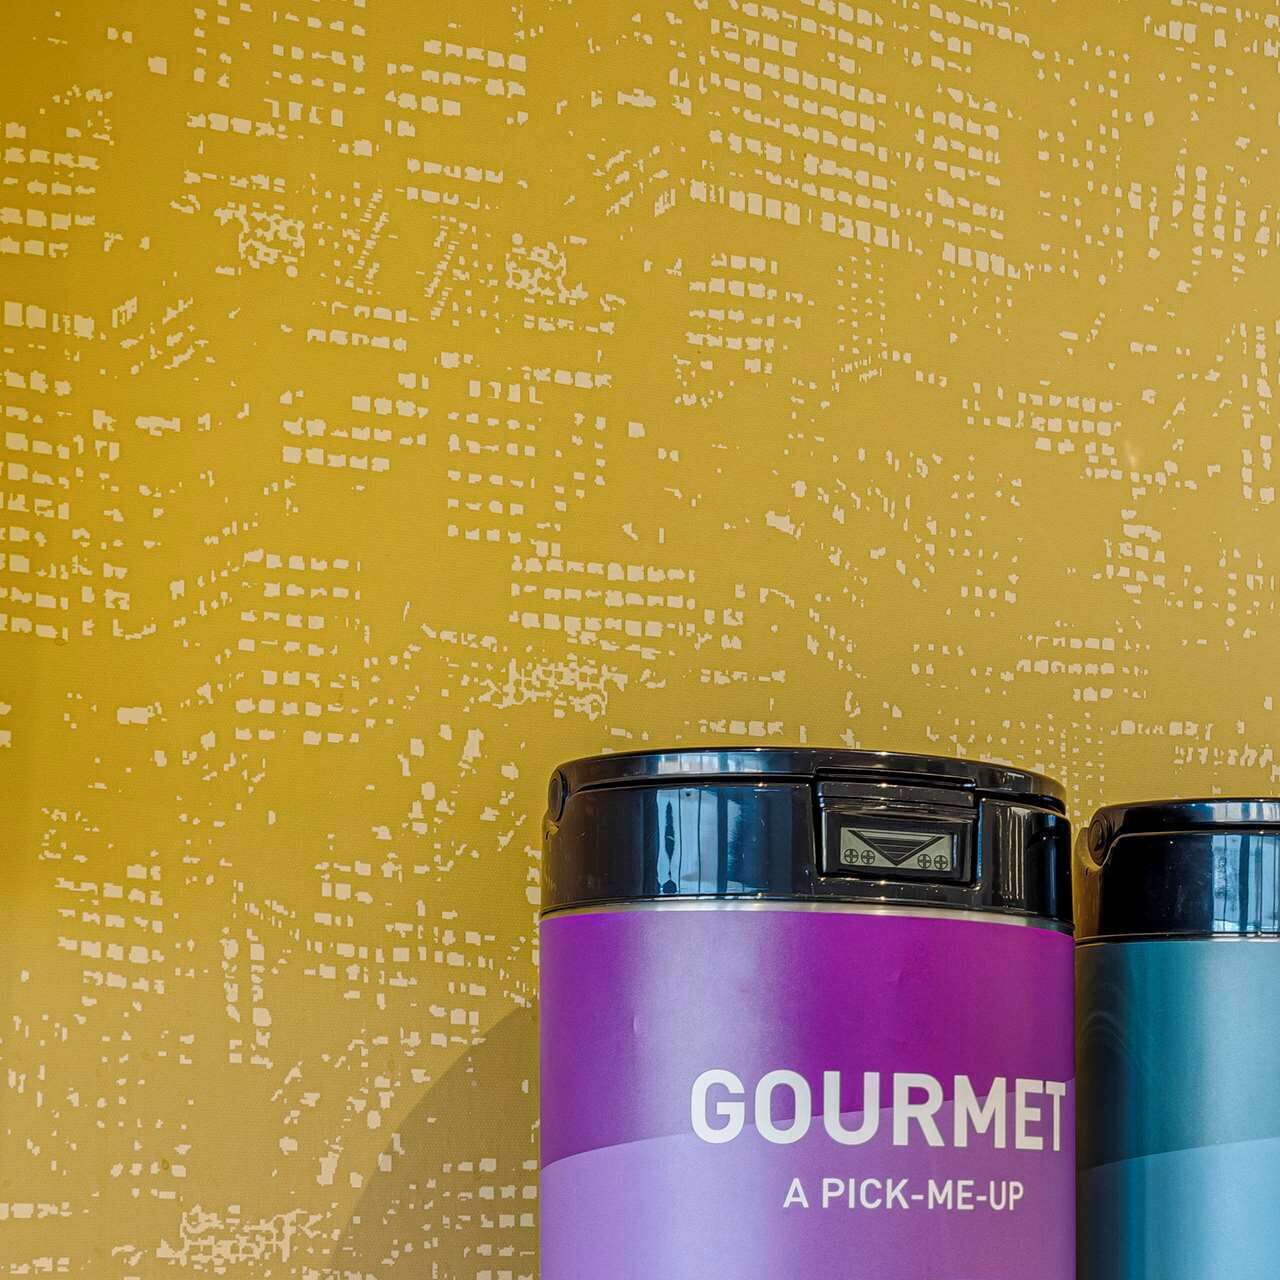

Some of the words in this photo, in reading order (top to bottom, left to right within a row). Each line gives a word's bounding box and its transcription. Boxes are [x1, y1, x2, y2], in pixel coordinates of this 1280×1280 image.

[690, 1069, 1066, 1151] GOURMET
[782, 1177, 809, 1208] A
[822, 1178, 1024, 1210] PICK-ME-UP
